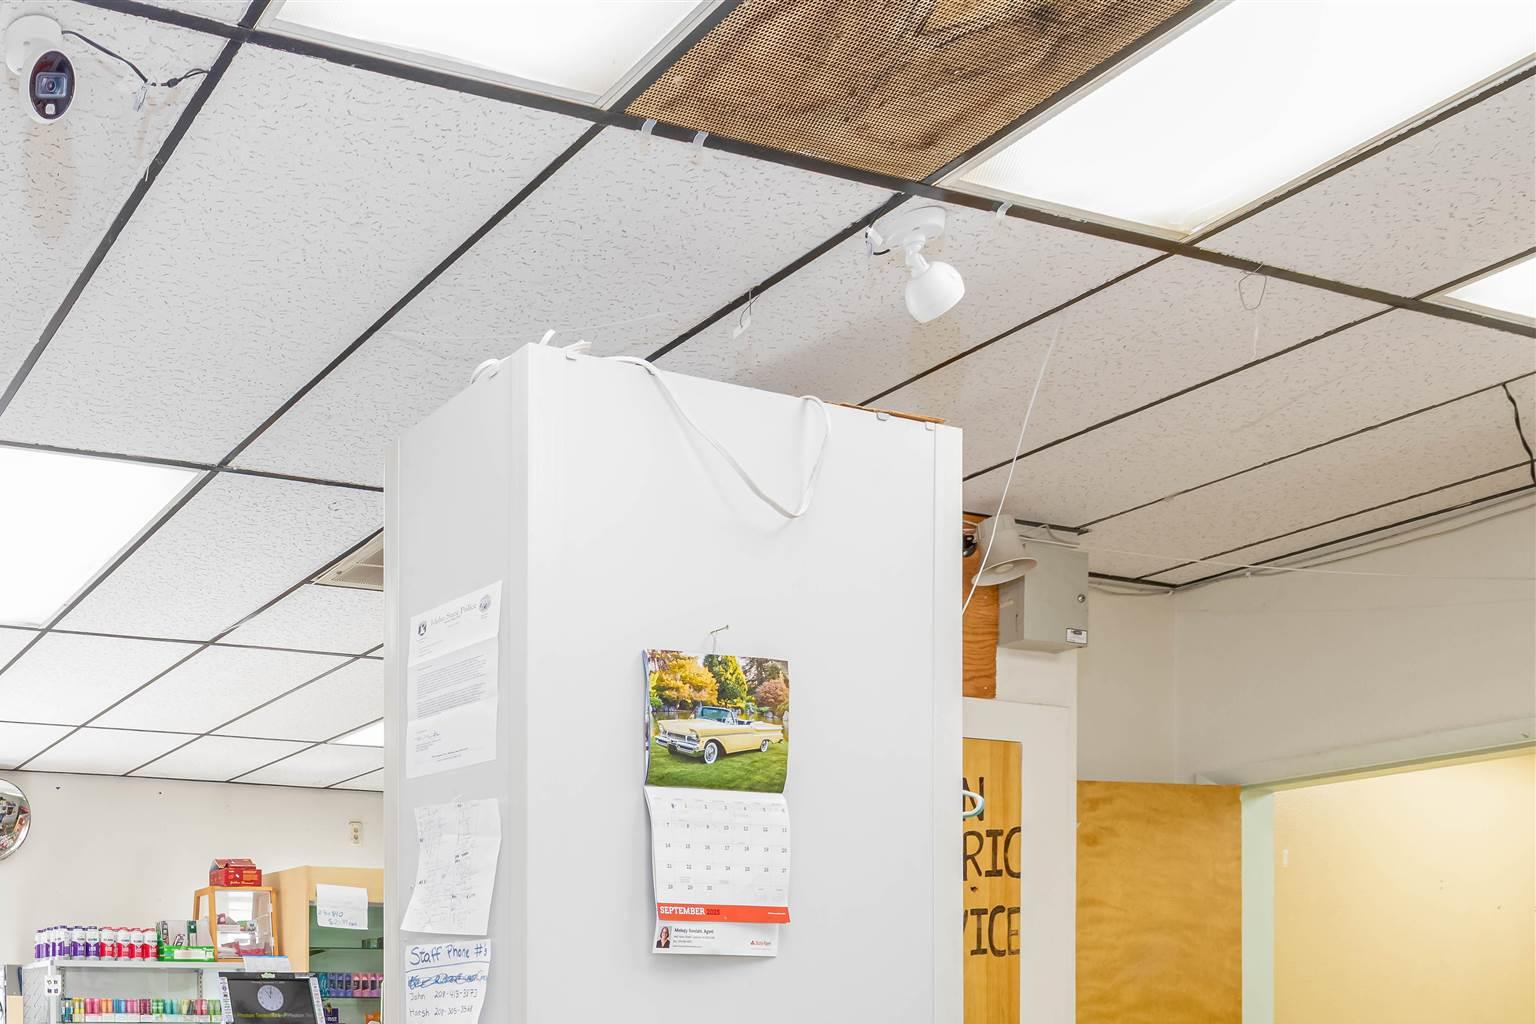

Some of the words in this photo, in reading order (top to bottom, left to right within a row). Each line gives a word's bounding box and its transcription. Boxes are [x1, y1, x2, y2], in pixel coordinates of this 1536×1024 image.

[659, 906, 705, 915] SEPTEMBER
[409, 946, 443, 966] Staff
[445, 944, 470, 959] Phone
